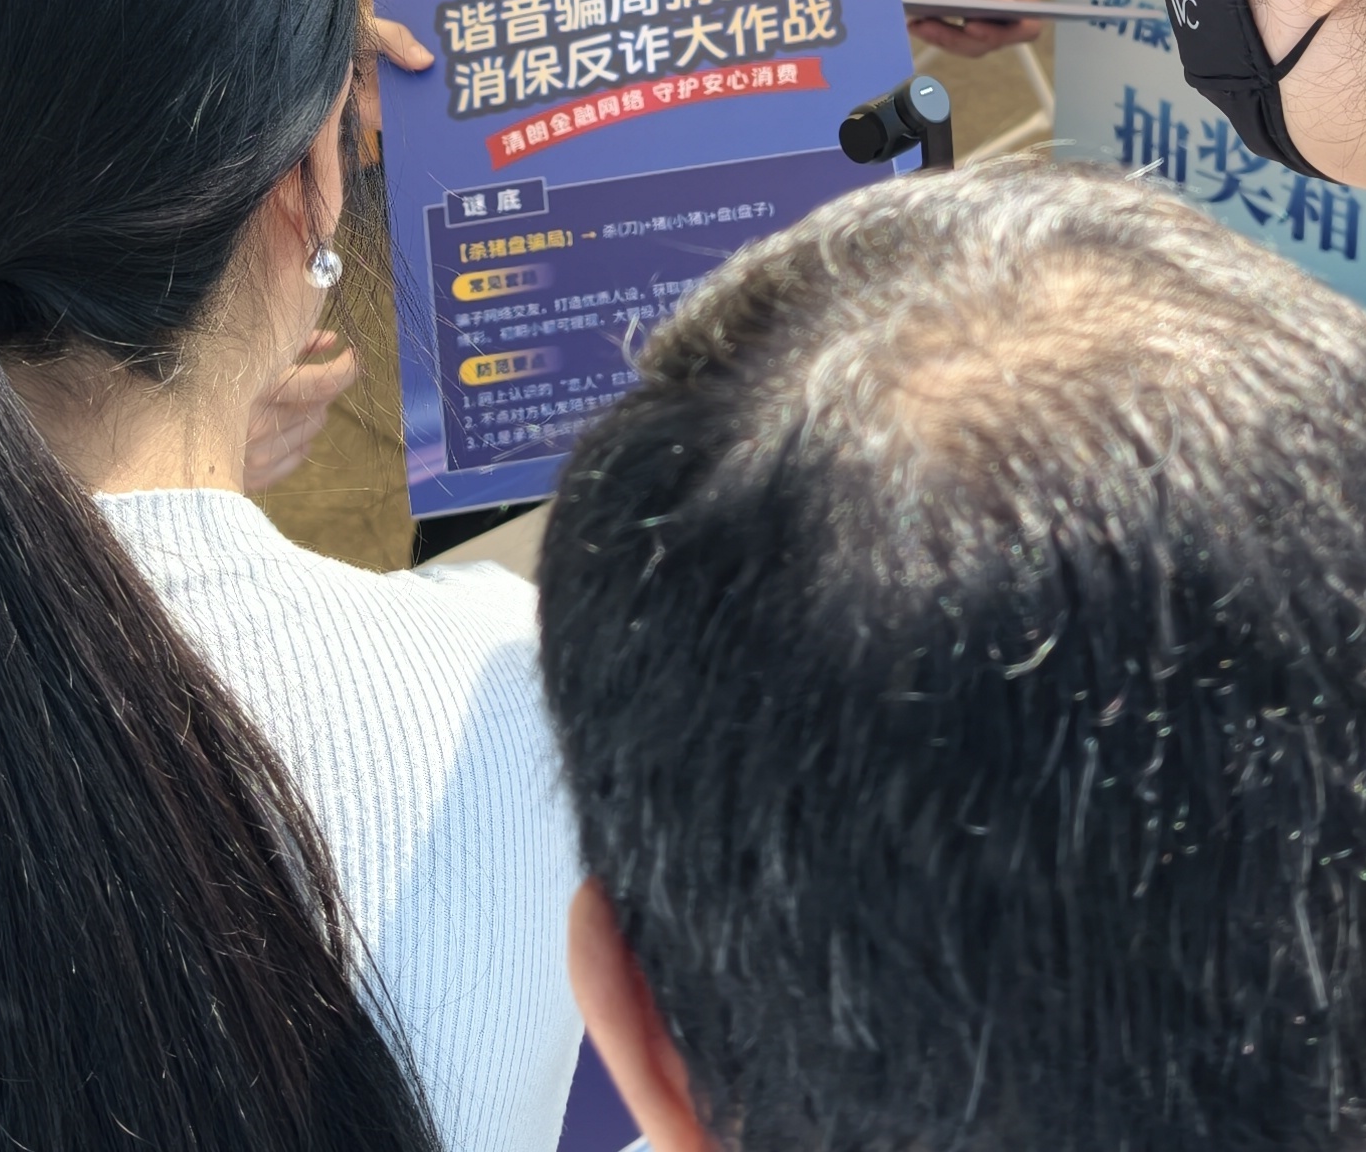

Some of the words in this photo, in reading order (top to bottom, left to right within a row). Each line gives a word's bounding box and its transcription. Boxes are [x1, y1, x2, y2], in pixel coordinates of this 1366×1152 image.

[501, 90, 646, 156] 清朗金融网络
[652, 62, 799, 105] 守护安心消费
[461, 188, 523, 218] 谜底
